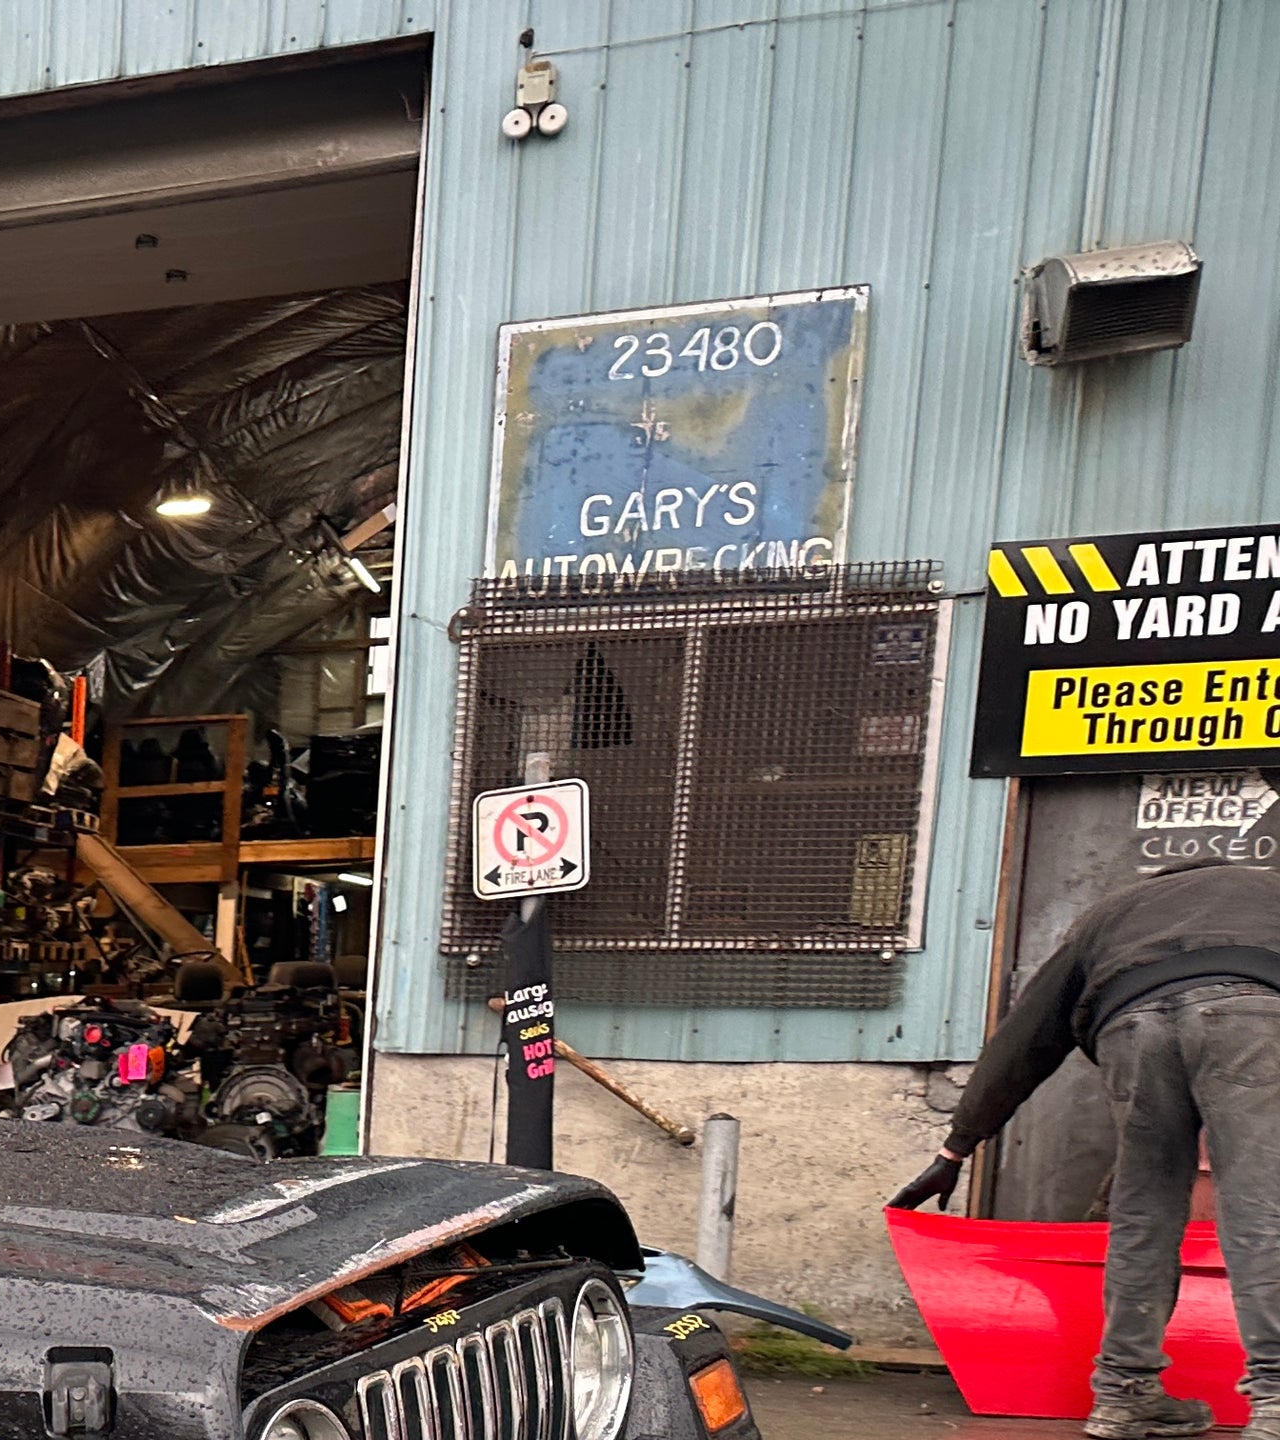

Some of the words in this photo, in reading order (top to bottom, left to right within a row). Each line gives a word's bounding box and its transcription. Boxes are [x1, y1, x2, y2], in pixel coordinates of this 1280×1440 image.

[609, 321, 783, 380] 23480
[580, 481, 757, 537] GARY'S
[1023, 600, 1090, 645] NO
[1111, 592, 1241, 640] YARD
[1052, 676, 1184, 710] Please
[1204, 667, 1280, 703] Ent
[1082, 707, 1243, 747] Through
[1142, 797, 1260, 822] OFFICE
[1141, 834, 1278, 860] CLOSED
[504, 871, 528, 886] FIRE
[522, 1039, 553, 1061] HOT
